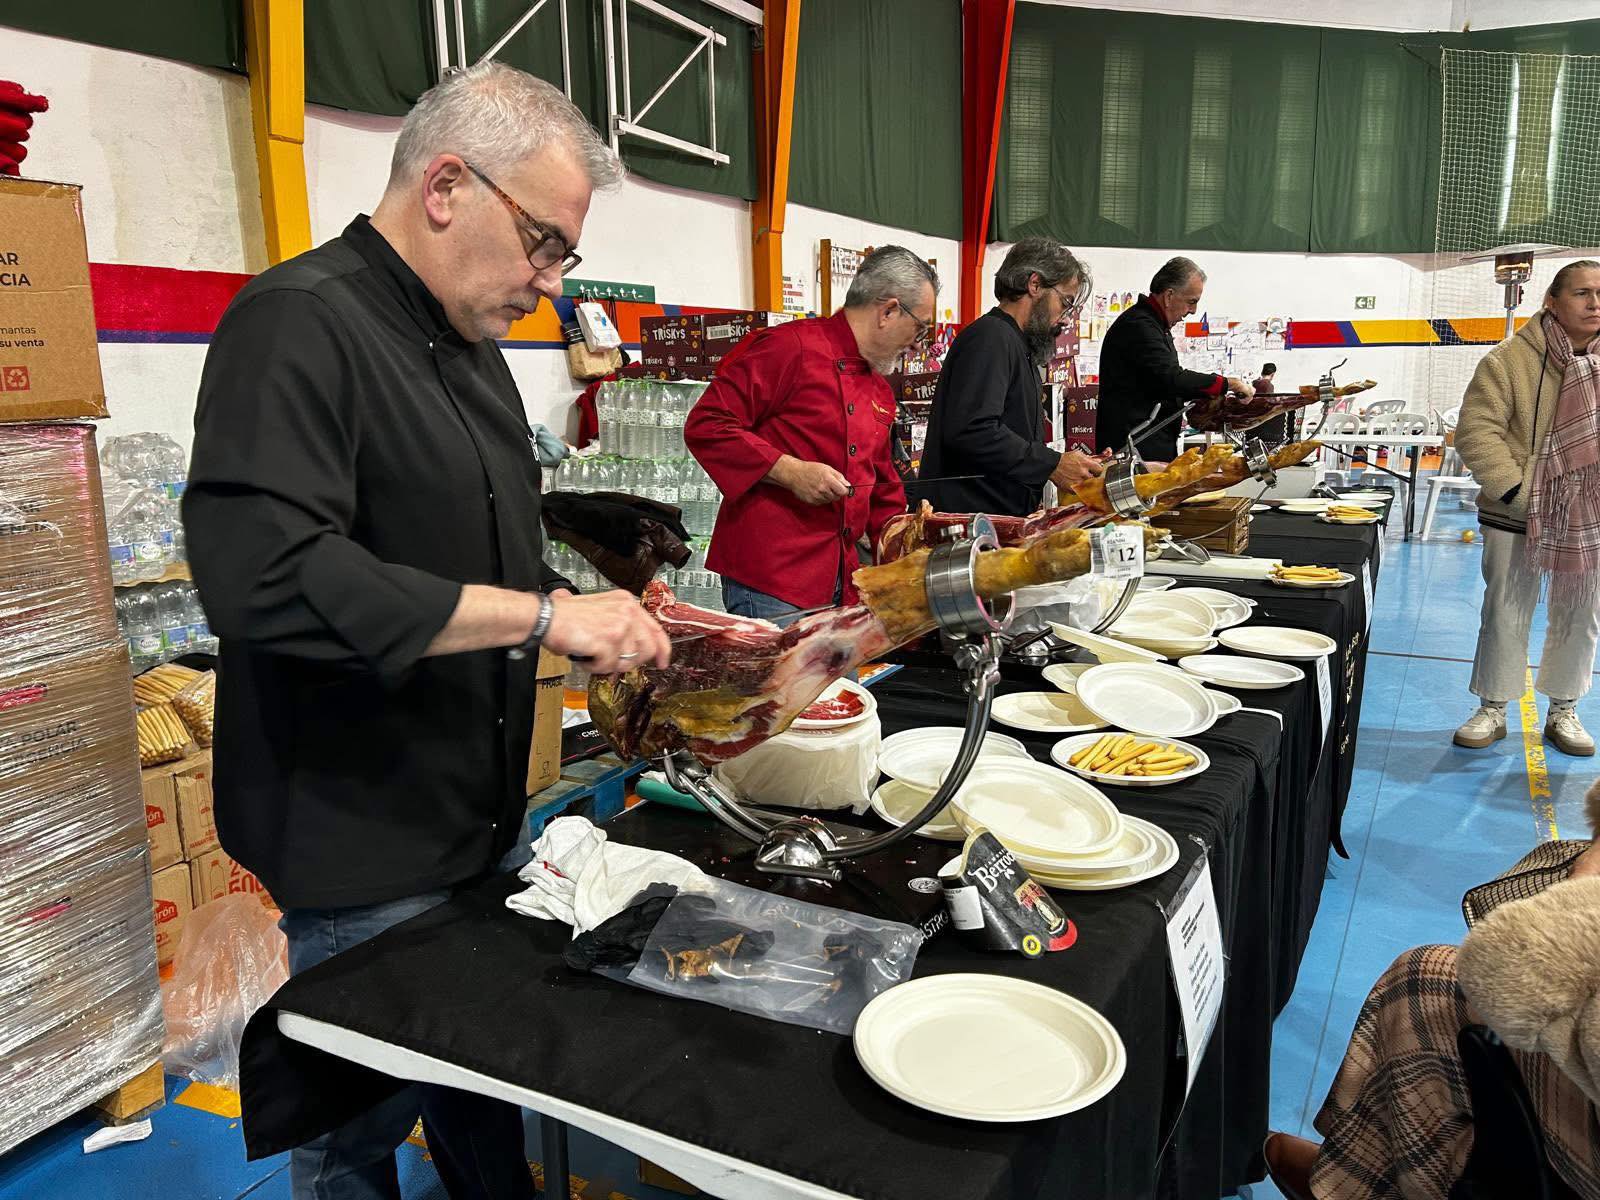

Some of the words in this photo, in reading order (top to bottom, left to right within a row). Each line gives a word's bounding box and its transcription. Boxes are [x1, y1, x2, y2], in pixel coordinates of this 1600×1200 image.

[0, 272, 31, 287] CIA
[652, 327, 686, 342] TRISKYS
[14, 339, 45, 347] venta
[1071, 426, 1093, 434] TRISKYS
[1118, 547, 1136, 562] 12
[146, 810, 161, 823] ón
[229, 859, 242, 877] 2
